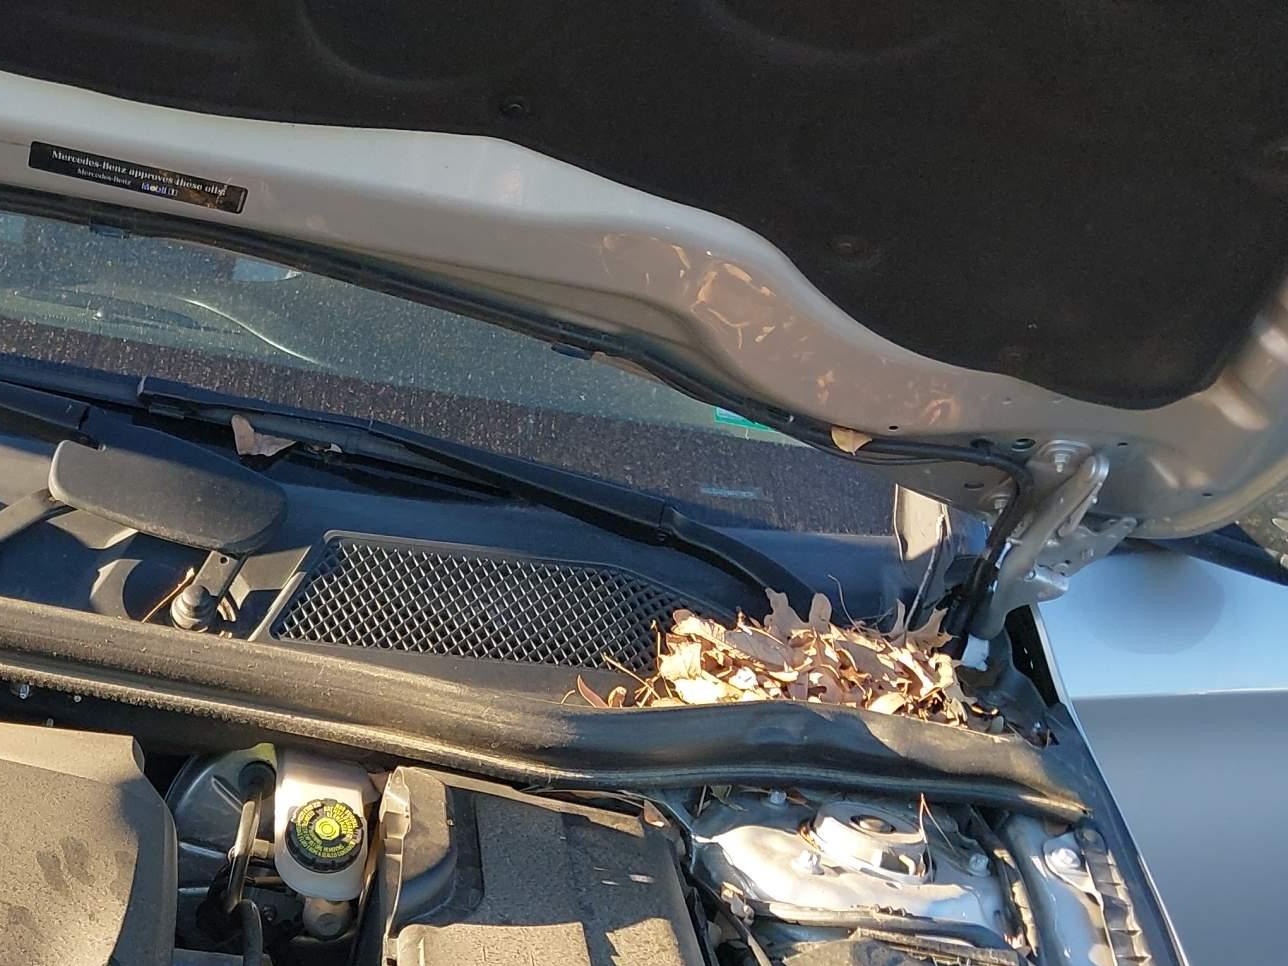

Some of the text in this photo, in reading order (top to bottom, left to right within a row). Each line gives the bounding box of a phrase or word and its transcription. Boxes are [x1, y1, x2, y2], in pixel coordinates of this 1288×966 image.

[51, 150, 128, 174] Mercedes-Benz
[128, 168, 174, 185] approves
[174, 176, 204, 191] these
[76, 167, 132, 186] Mercedes-Benz
